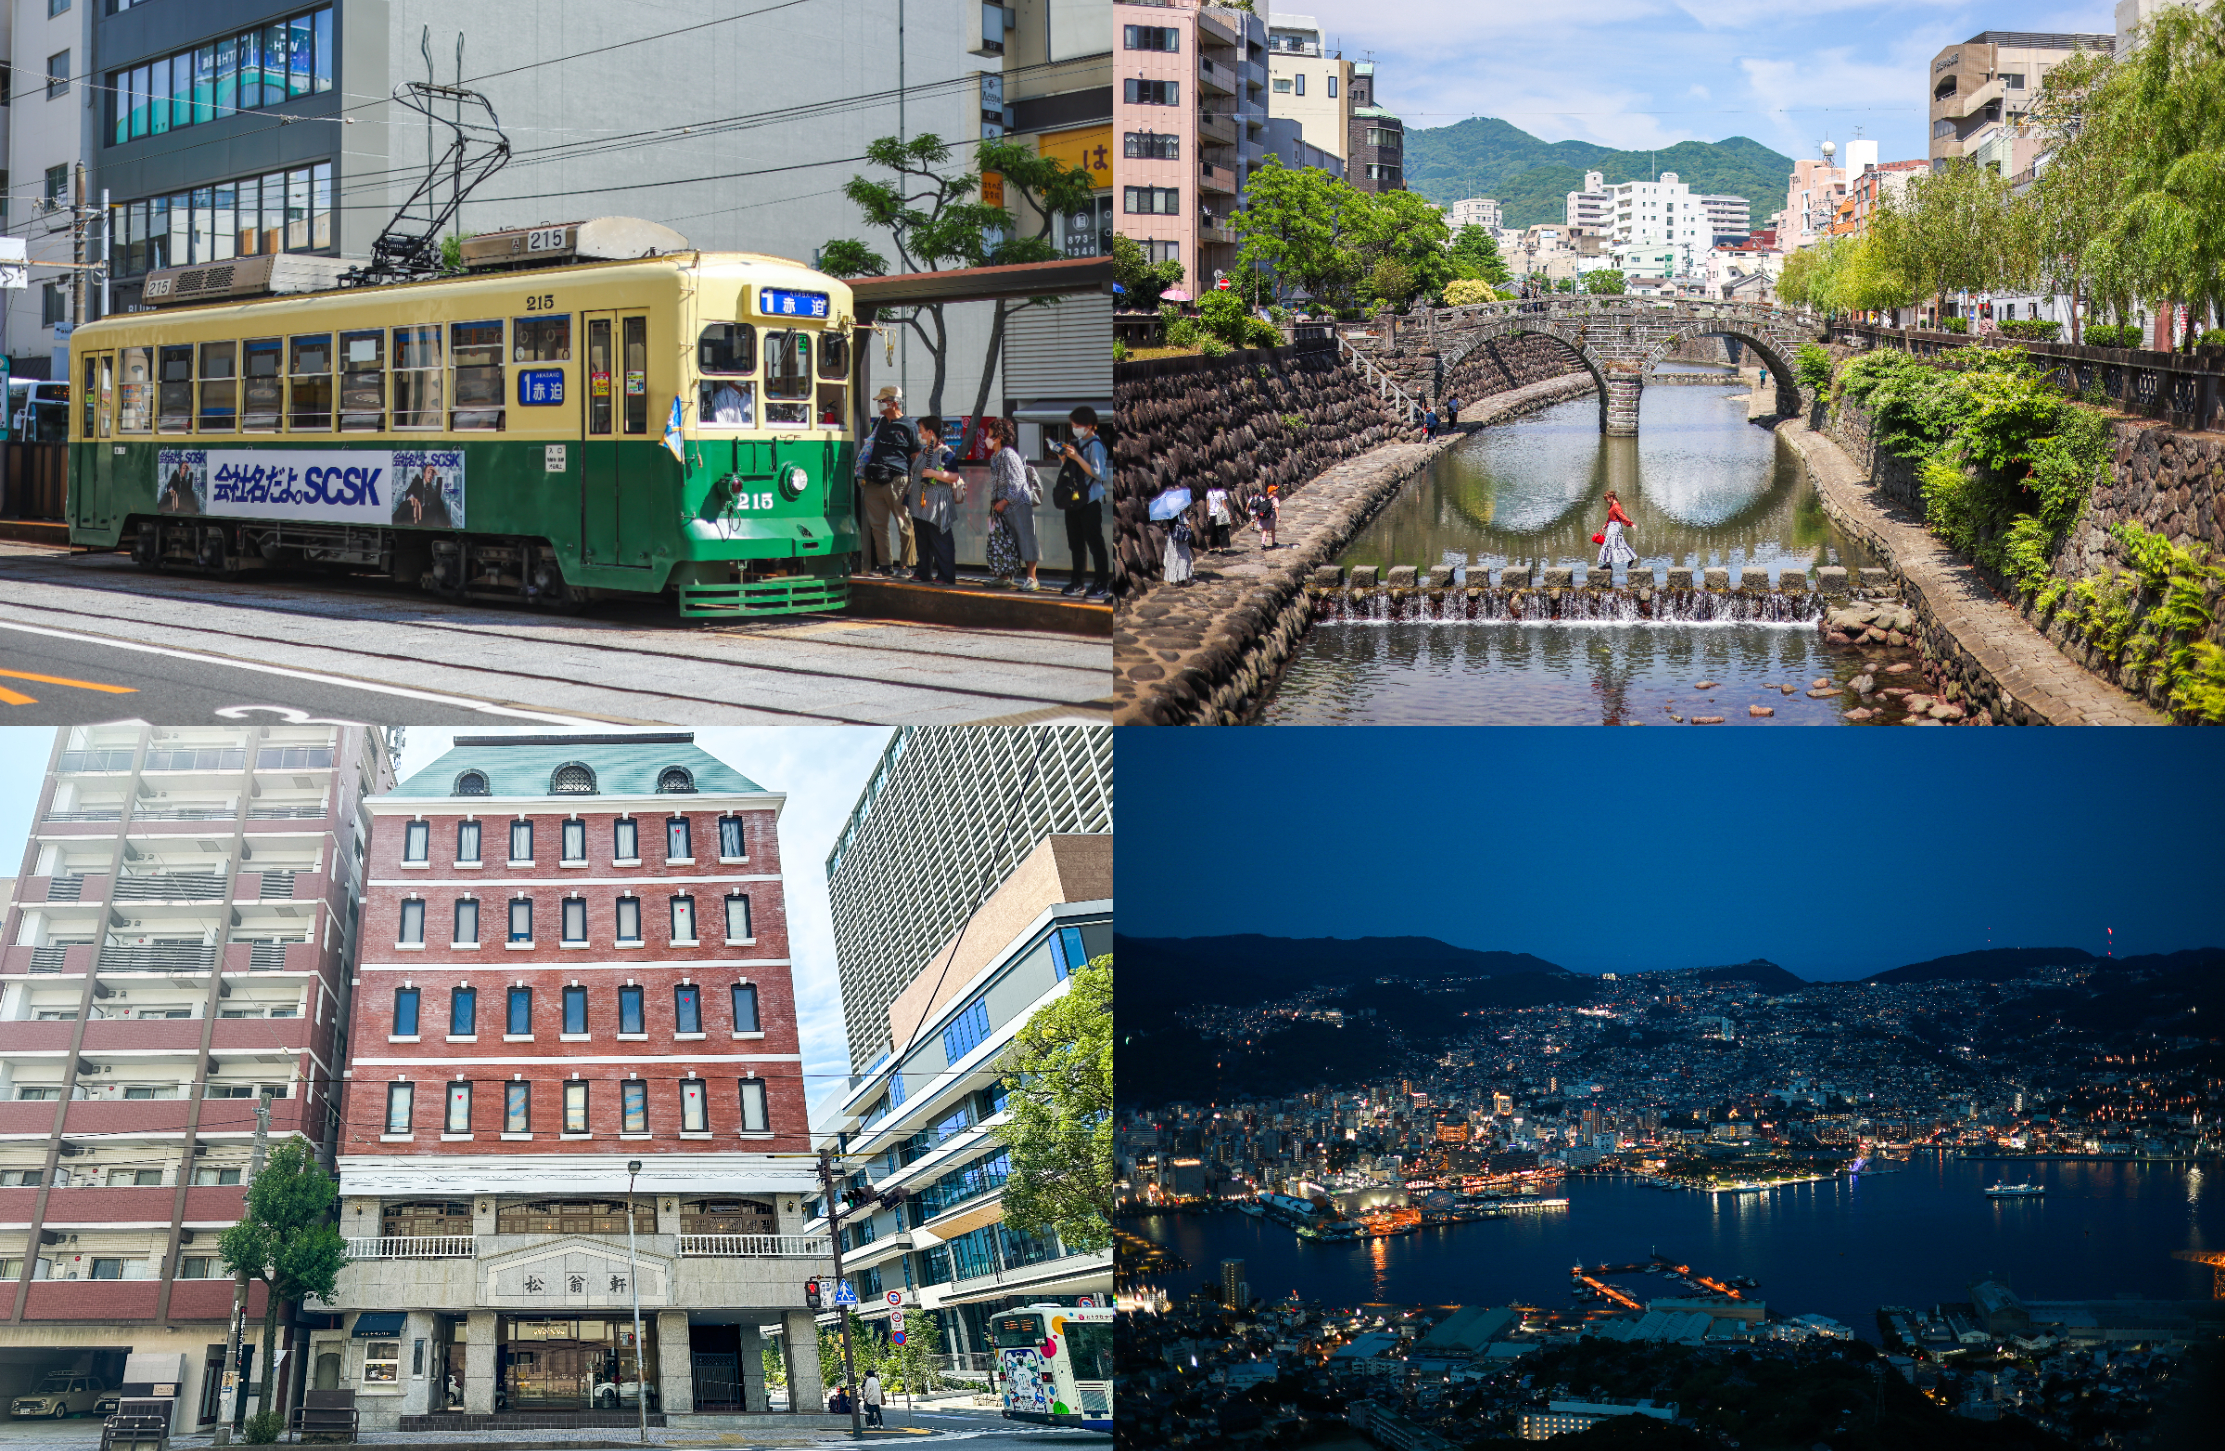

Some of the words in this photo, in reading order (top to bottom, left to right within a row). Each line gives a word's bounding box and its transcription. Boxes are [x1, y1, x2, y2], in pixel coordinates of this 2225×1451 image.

[1083, 144, 1109, 171] は
[530, 229, 562, 250] 215
[1067, 234, 1095, 245] 873-
[1067, 246, 1095, 256] 1348
[148, 280, 168, 296] 215
[526, 294, 554, 311] 215
[761, 289, 774, 313] 1
[783, 297, 825, 316] 赤迫
[524, 373, 531, 402] 1
[532, 382, 563, 401] 赤迫
[736, 491, 774, 510] 215
[525, 1274, 627, 1294] 松翁軒
